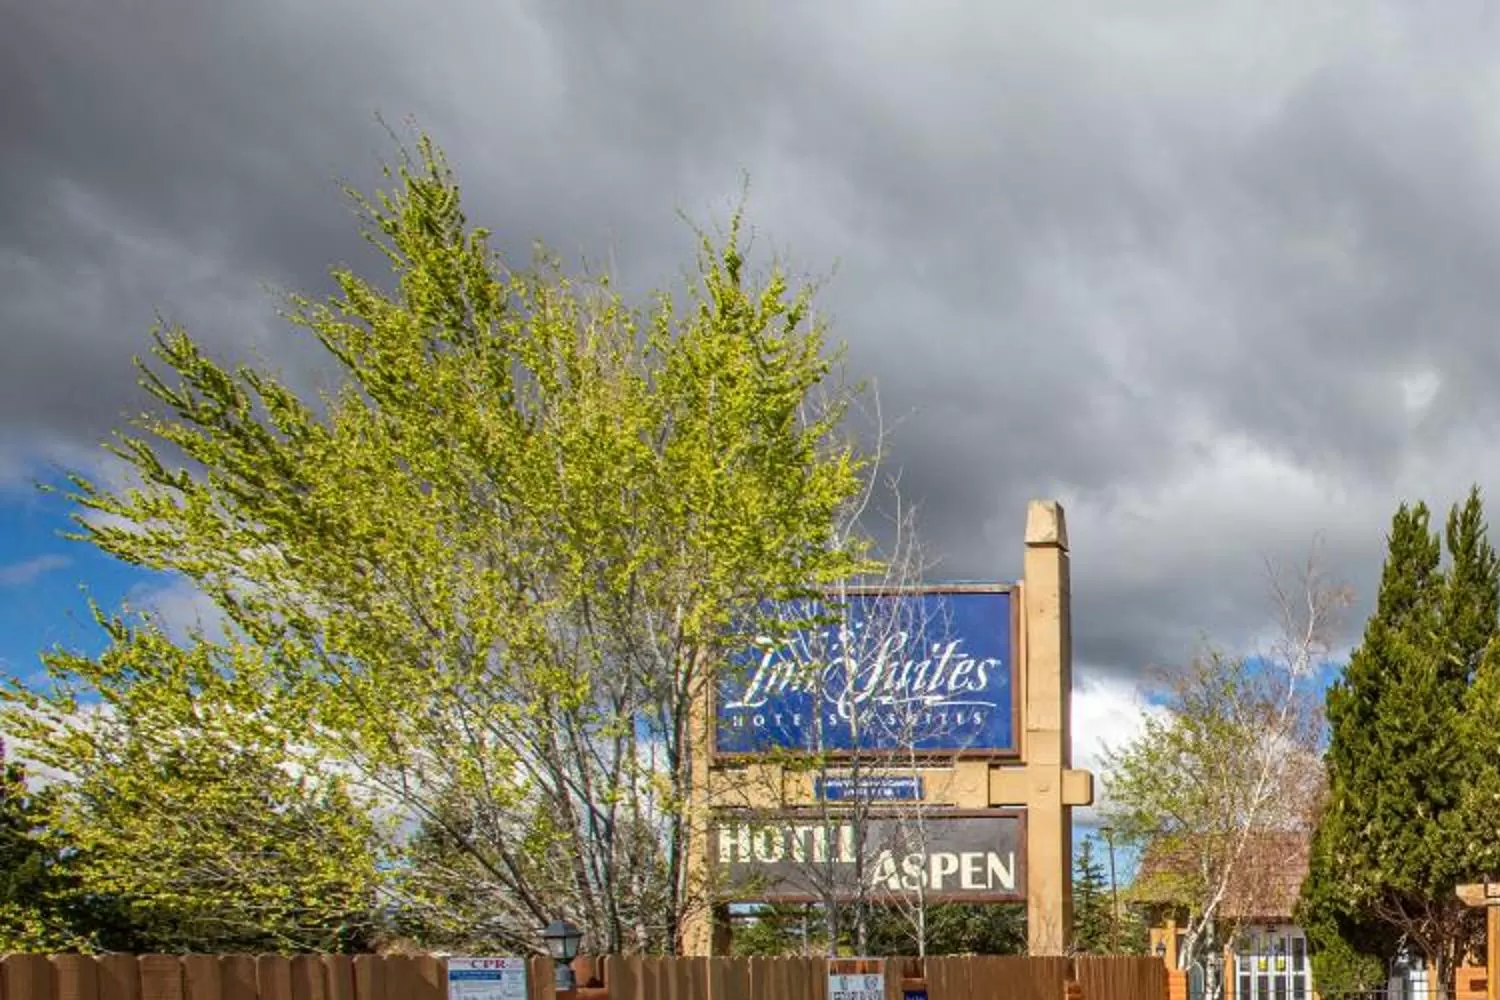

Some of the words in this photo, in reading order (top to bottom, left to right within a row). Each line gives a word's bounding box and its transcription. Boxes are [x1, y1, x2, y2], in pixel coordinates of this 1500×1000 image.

[732, 713, 838, 727] HOTES
[719, 823, 857, 863] HOTEL
[872, 849, 1016, 892] ASPEN
[471, 959, 506, 969] CPR
